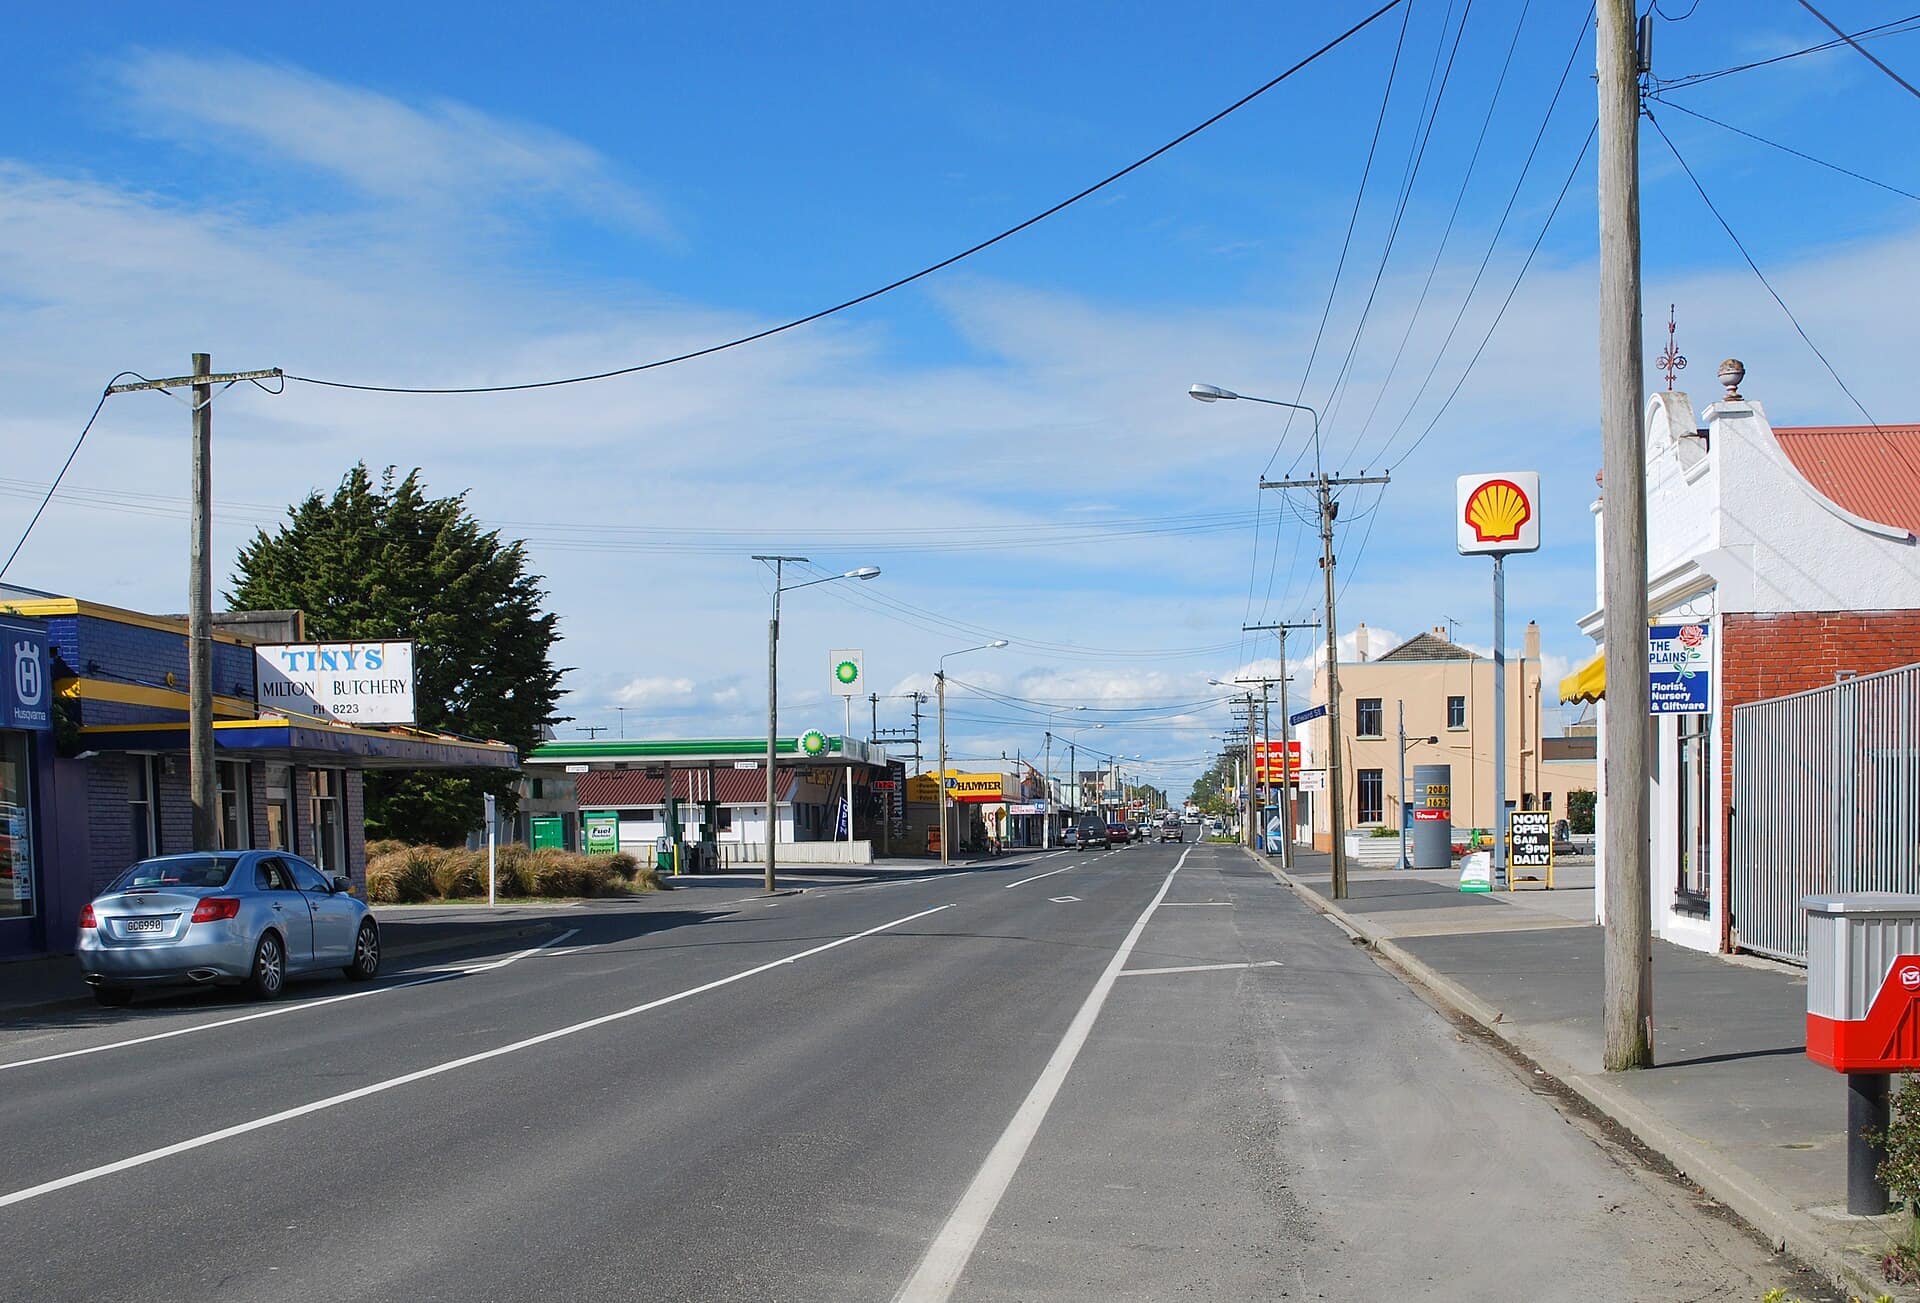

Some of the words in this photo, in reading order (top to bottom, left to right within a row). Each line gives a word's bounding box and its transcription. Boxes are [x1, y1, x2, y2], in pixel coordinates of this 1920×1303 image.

[1650, 641, 1670, 651] THE
[281, 648, 383, 672] TINY'S
[1649, 652, 1687, 663] PLAINS
[263, 680, 315, 697] MILTON
[333, 679, 407, 696] BUTCHERY
[1651, 682, 1687, 692] Florist,
[1651, 692, 1691, 702] Nursery
[313, 705, 325, 715] PH
[332, 704, 359, 714] 8223
[1651, 702, 1660, 711] &
[1662, 701, 1705, 711] Giftware
[15, 707, 46, 721] Husqvarna
[957, 781, 1002, 791] HAMMER
[1512, 814, 1548, 824] NOW
[1513, 824, 1549, 834] OPEN
[1513, 834, 1538, 845] 6AM
[1513, 854, 1549, 865] DAILY
